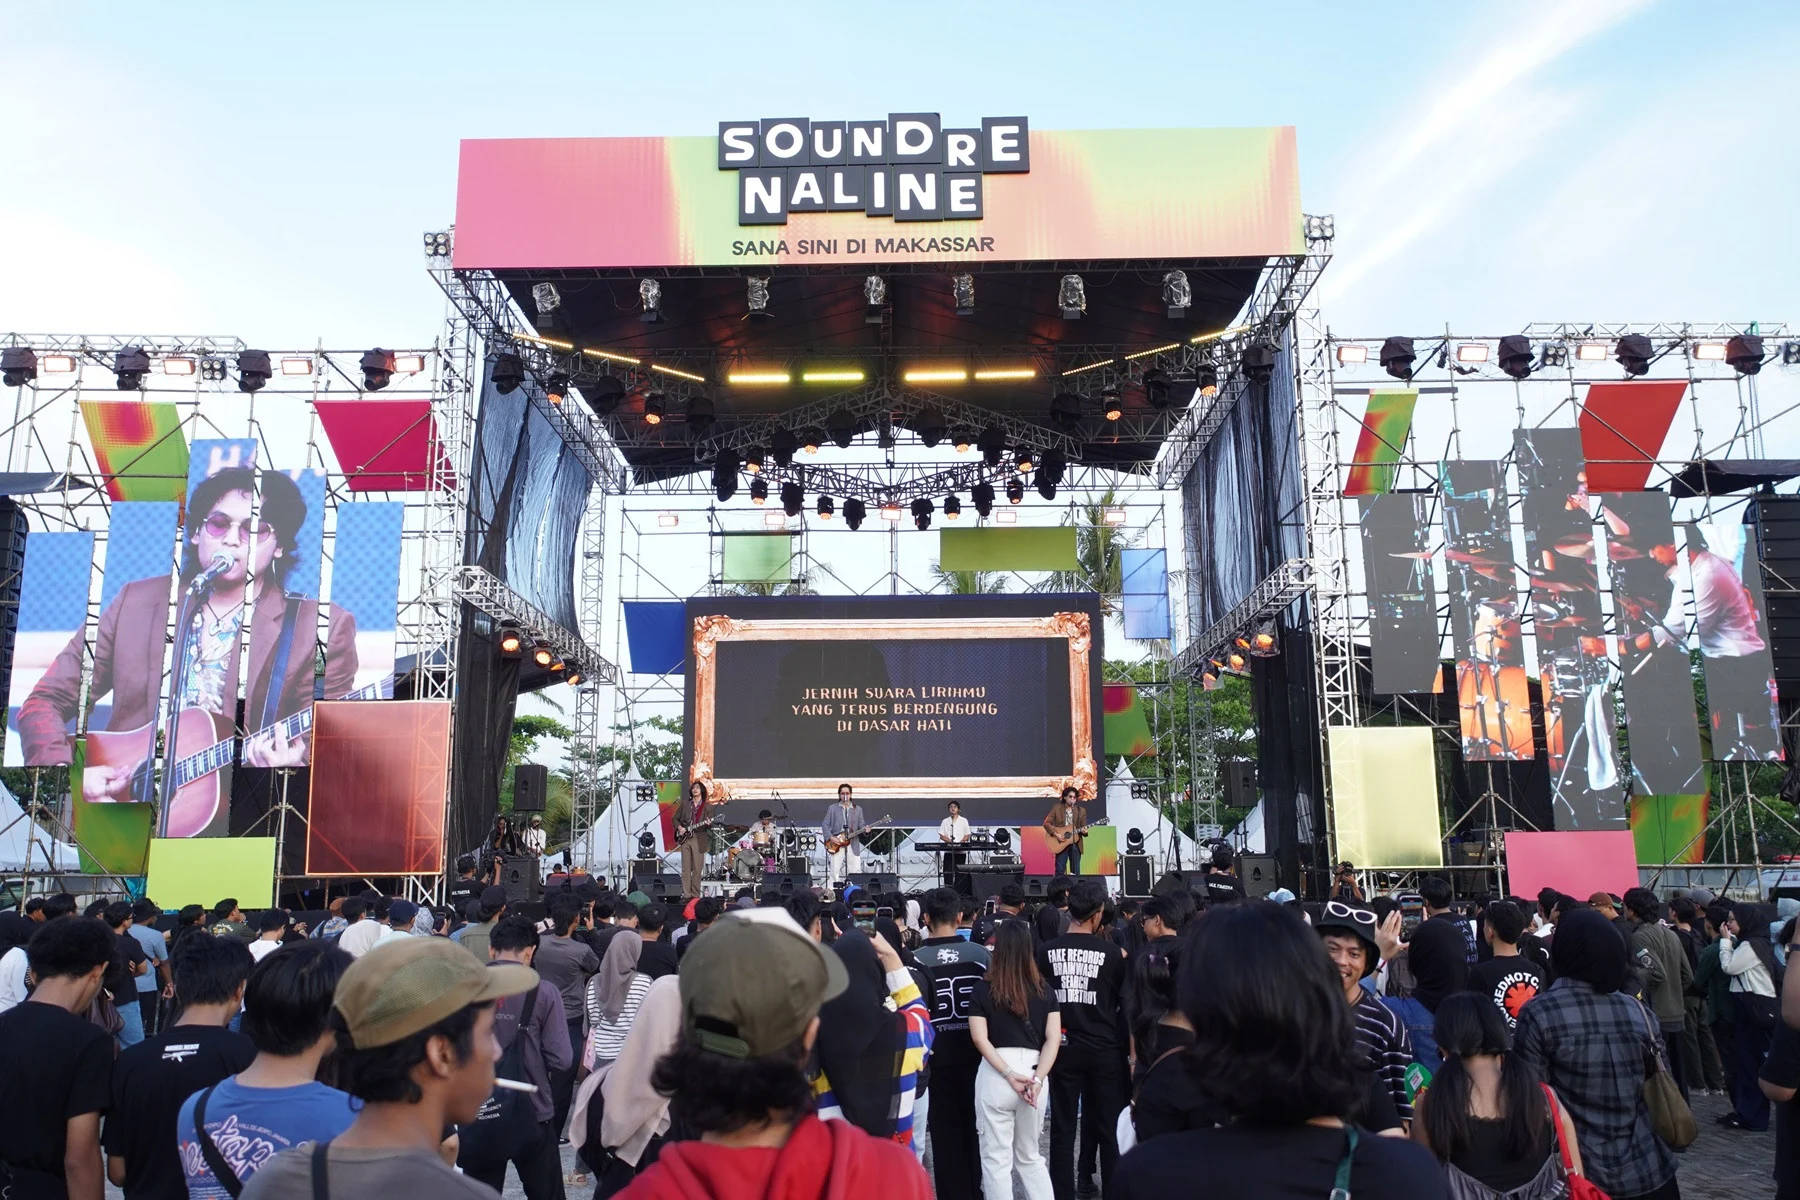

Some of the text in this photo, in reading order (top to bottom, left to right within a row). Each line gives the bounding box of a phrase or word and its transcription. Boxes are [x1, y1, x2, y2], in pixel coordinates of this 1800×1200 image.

[722, 120, 1021, 167] SOUNDRE
[744, 172, 977, 215] NALINE
[732, 237, 995, 256] SANA SINI DI MAKASSAR
[802, 686, 986, 700] JERNIH SUARA LIRIHMU
[791, 703, 998, 716] YANG TERUS BERDENGUNG
[837, 720, 952, 732] DI DASAR HATI
[1047, 948, 1106, 966] FAKE RECORDS
[1052, 961, 1100, 979] BRAINWASH
[1061, 975, 1089, 990] SEARCH
[1067, 988, 1097, 1005] DESTROY
